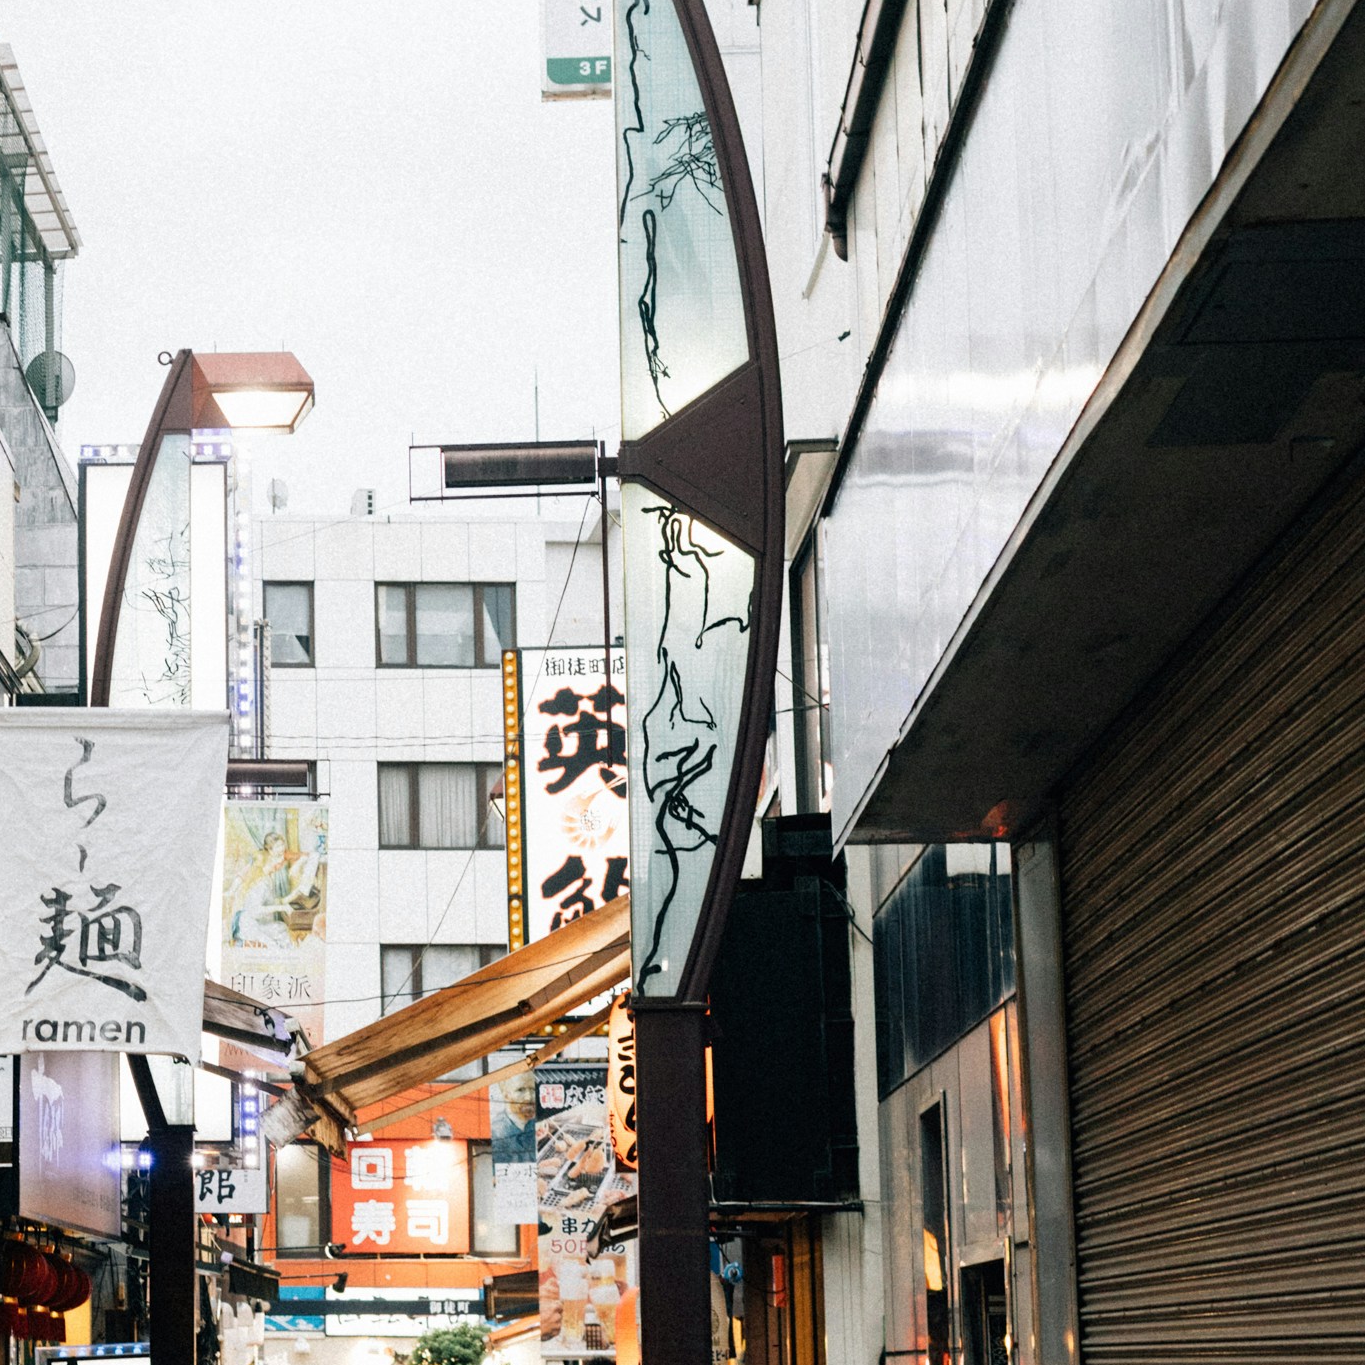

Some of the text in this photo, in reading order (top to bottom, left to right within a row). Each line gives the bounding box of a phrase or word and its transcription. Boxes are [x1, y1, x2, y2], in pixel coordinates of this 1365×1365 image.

[578, 60, 608, 76] 3F
[23, 735, 148, 1003] らー麺
[230, 972, 312, 1000] 印象派
[21, 1014, 147, 1046] ramen
[350, 1198, 449, 1246] 寿司
[561, 1216, 596, 1236] 串カ
[429, 1300, 471, 1315] 御徒町
